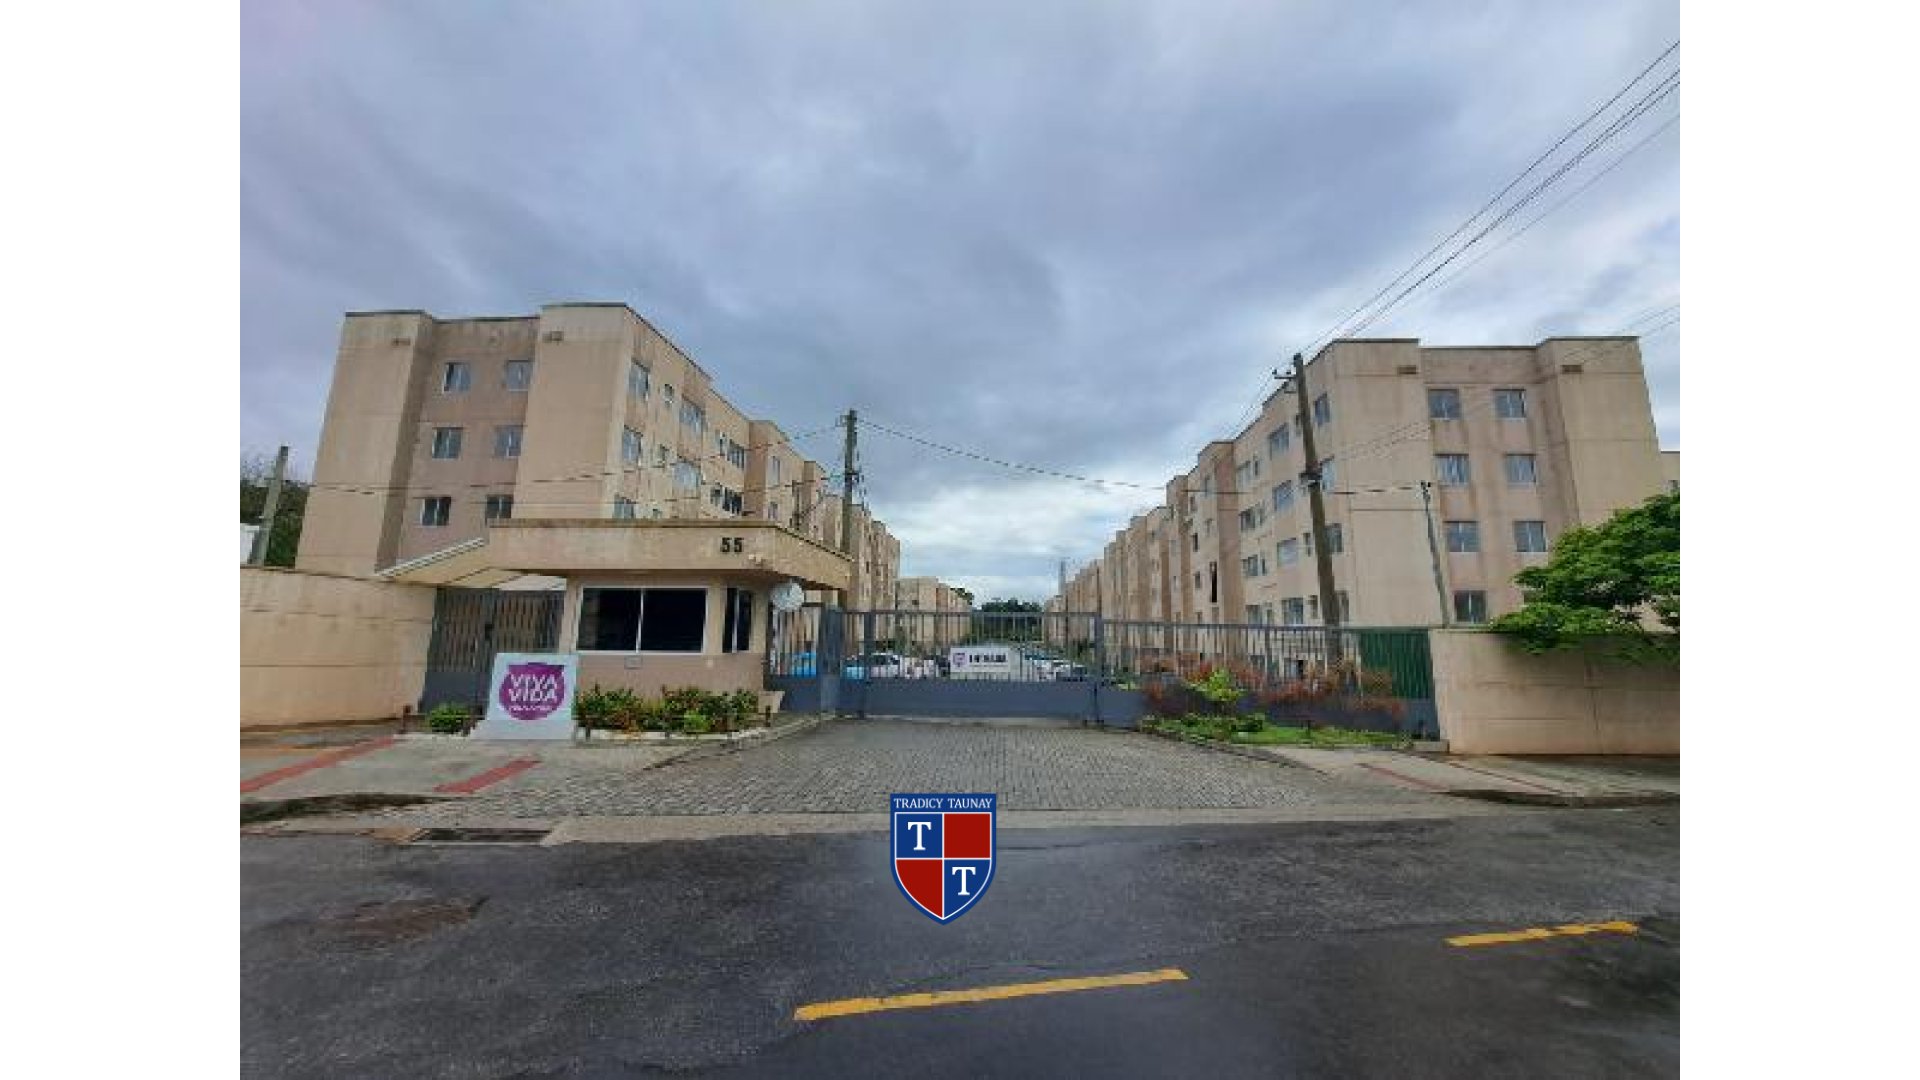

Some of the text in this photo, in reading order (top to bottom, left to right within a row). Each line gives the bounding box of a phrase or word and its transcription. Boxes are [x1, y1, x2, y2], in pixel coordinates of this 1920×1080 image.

[721, 537, 743, 553] 55
[510, 673, 557, 690] VIVA
[508, 688, 558, 702] VIDA
